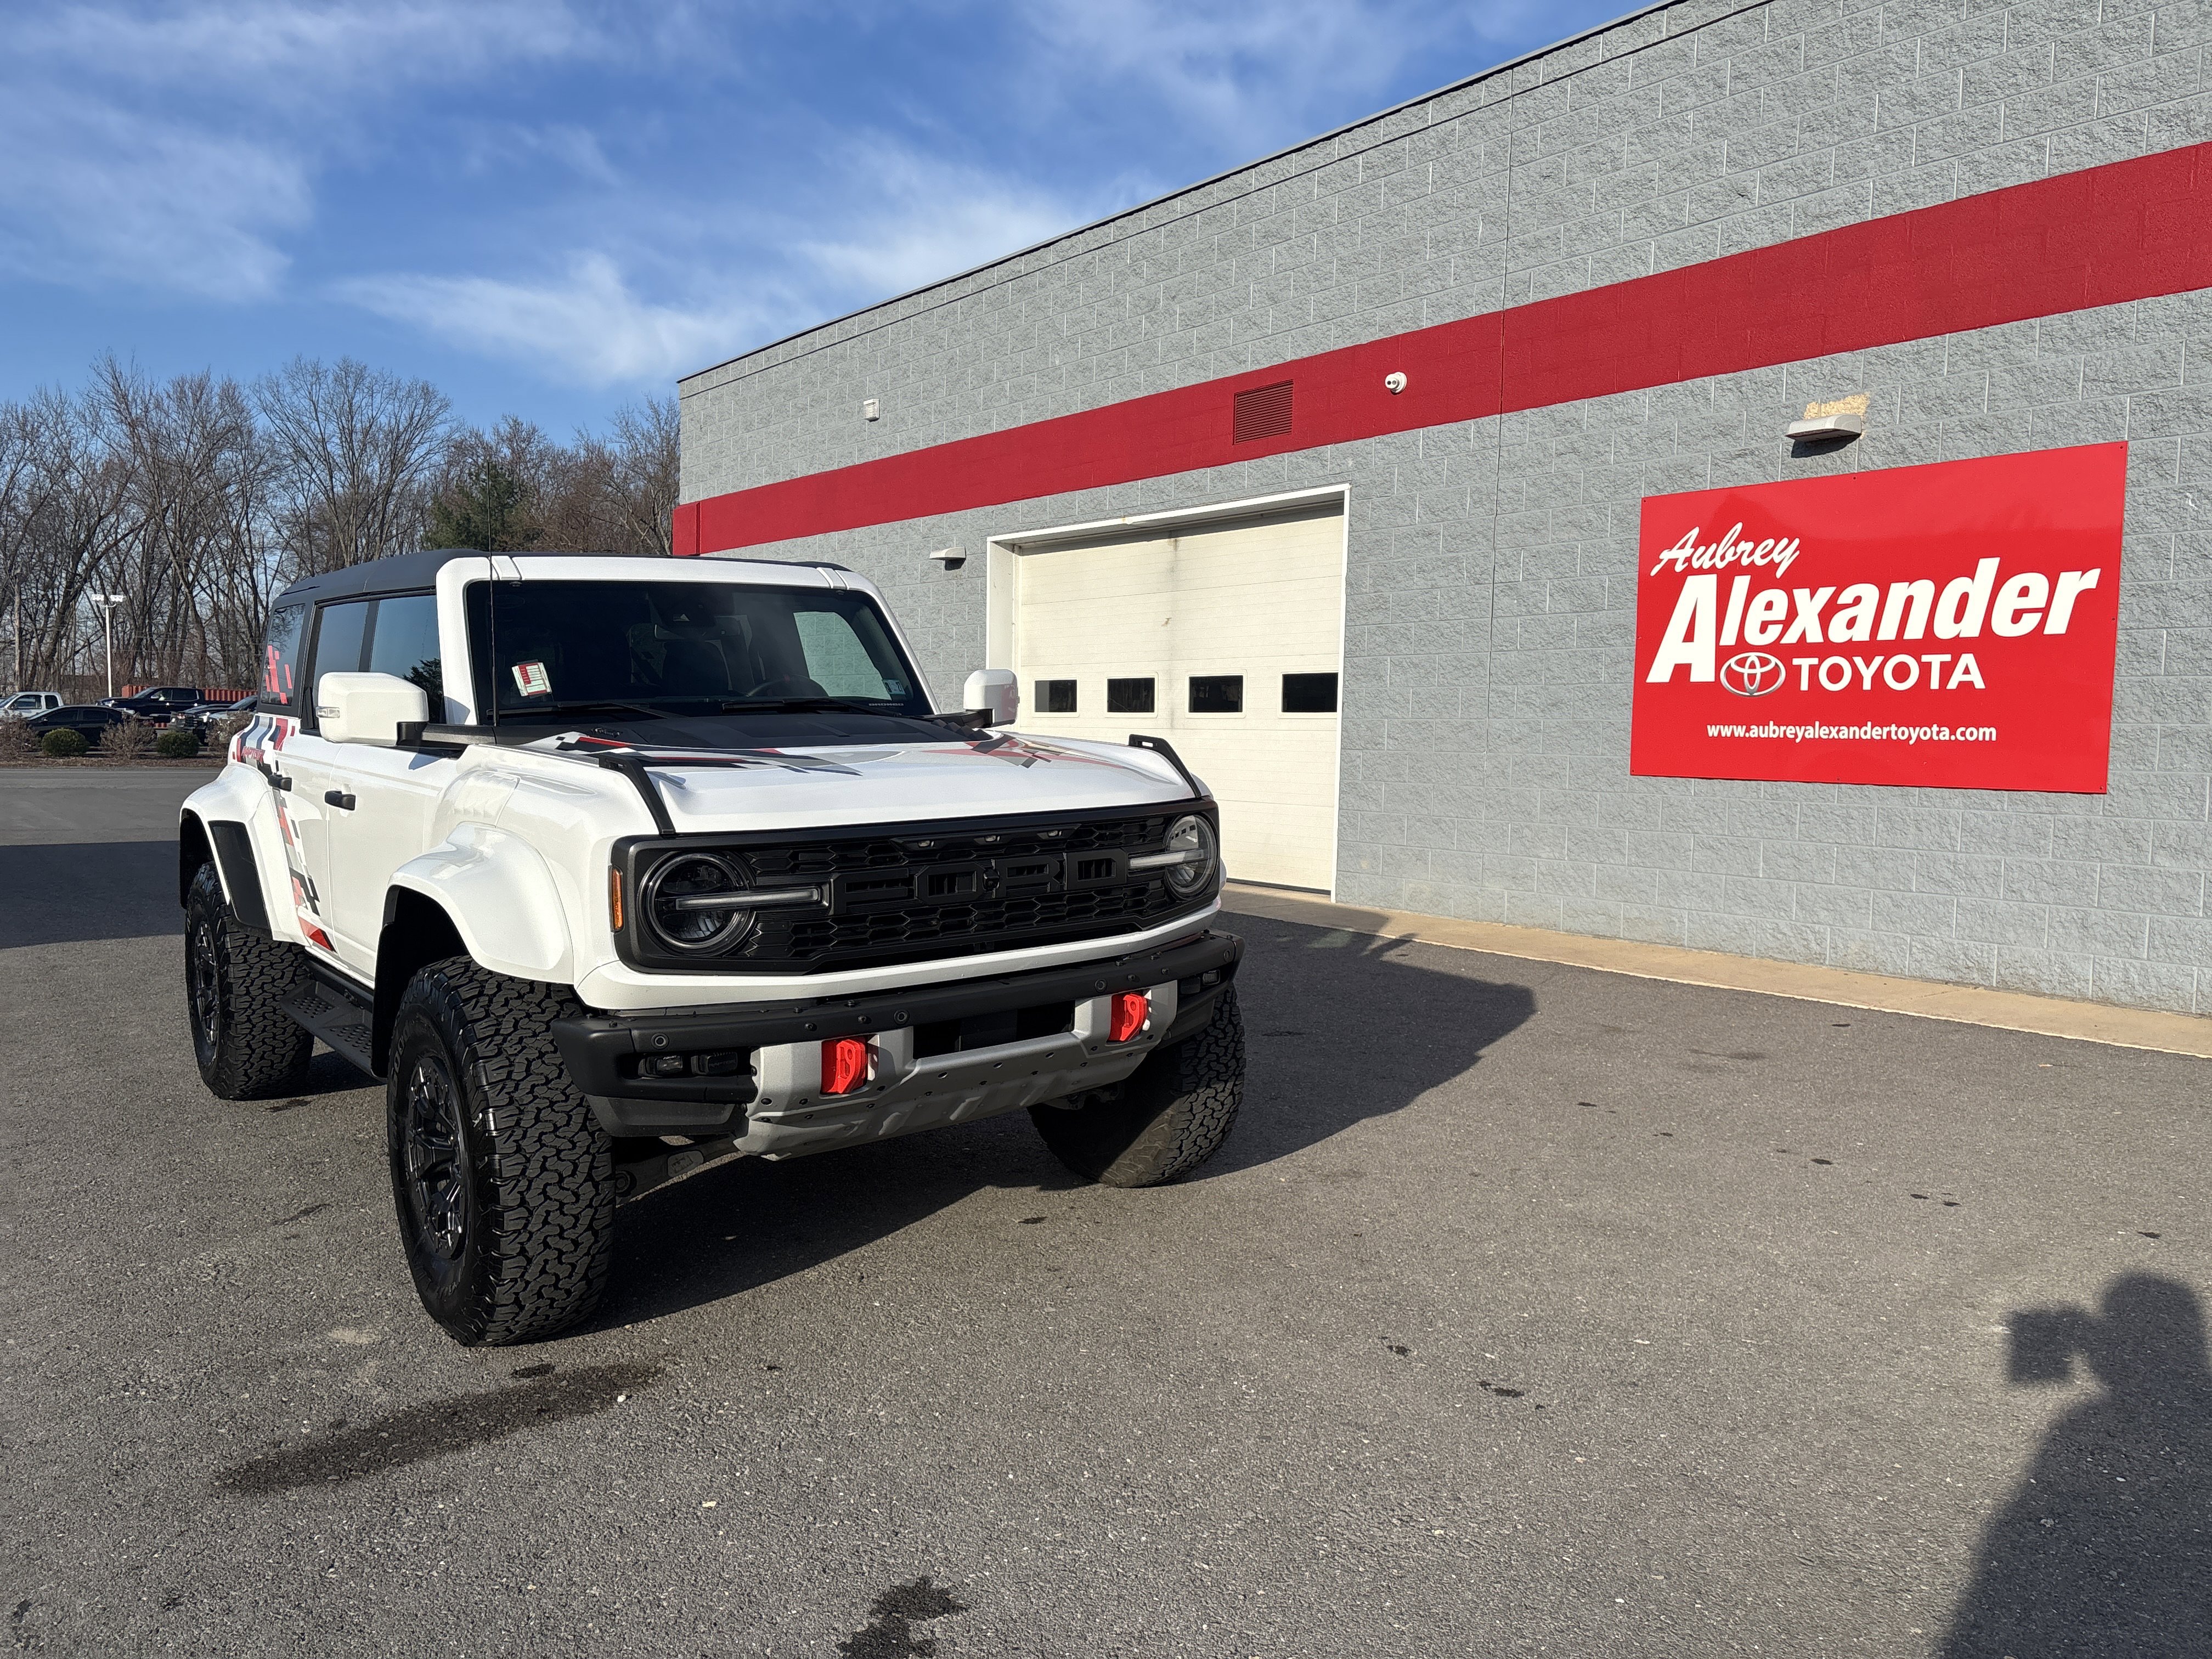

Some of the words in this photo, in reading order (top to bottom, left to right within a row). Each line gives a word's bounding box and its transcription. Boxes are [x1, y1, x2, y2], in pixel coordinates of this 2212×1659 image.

[1650, 522, 1800, 579] Aubrey
[1645, 557, 2101, 683] Alexander
[1792, 653, 1986, 691] TOYOTA
[1707, 720, 1997, 745] www.aubreyalexandertoyota.com
